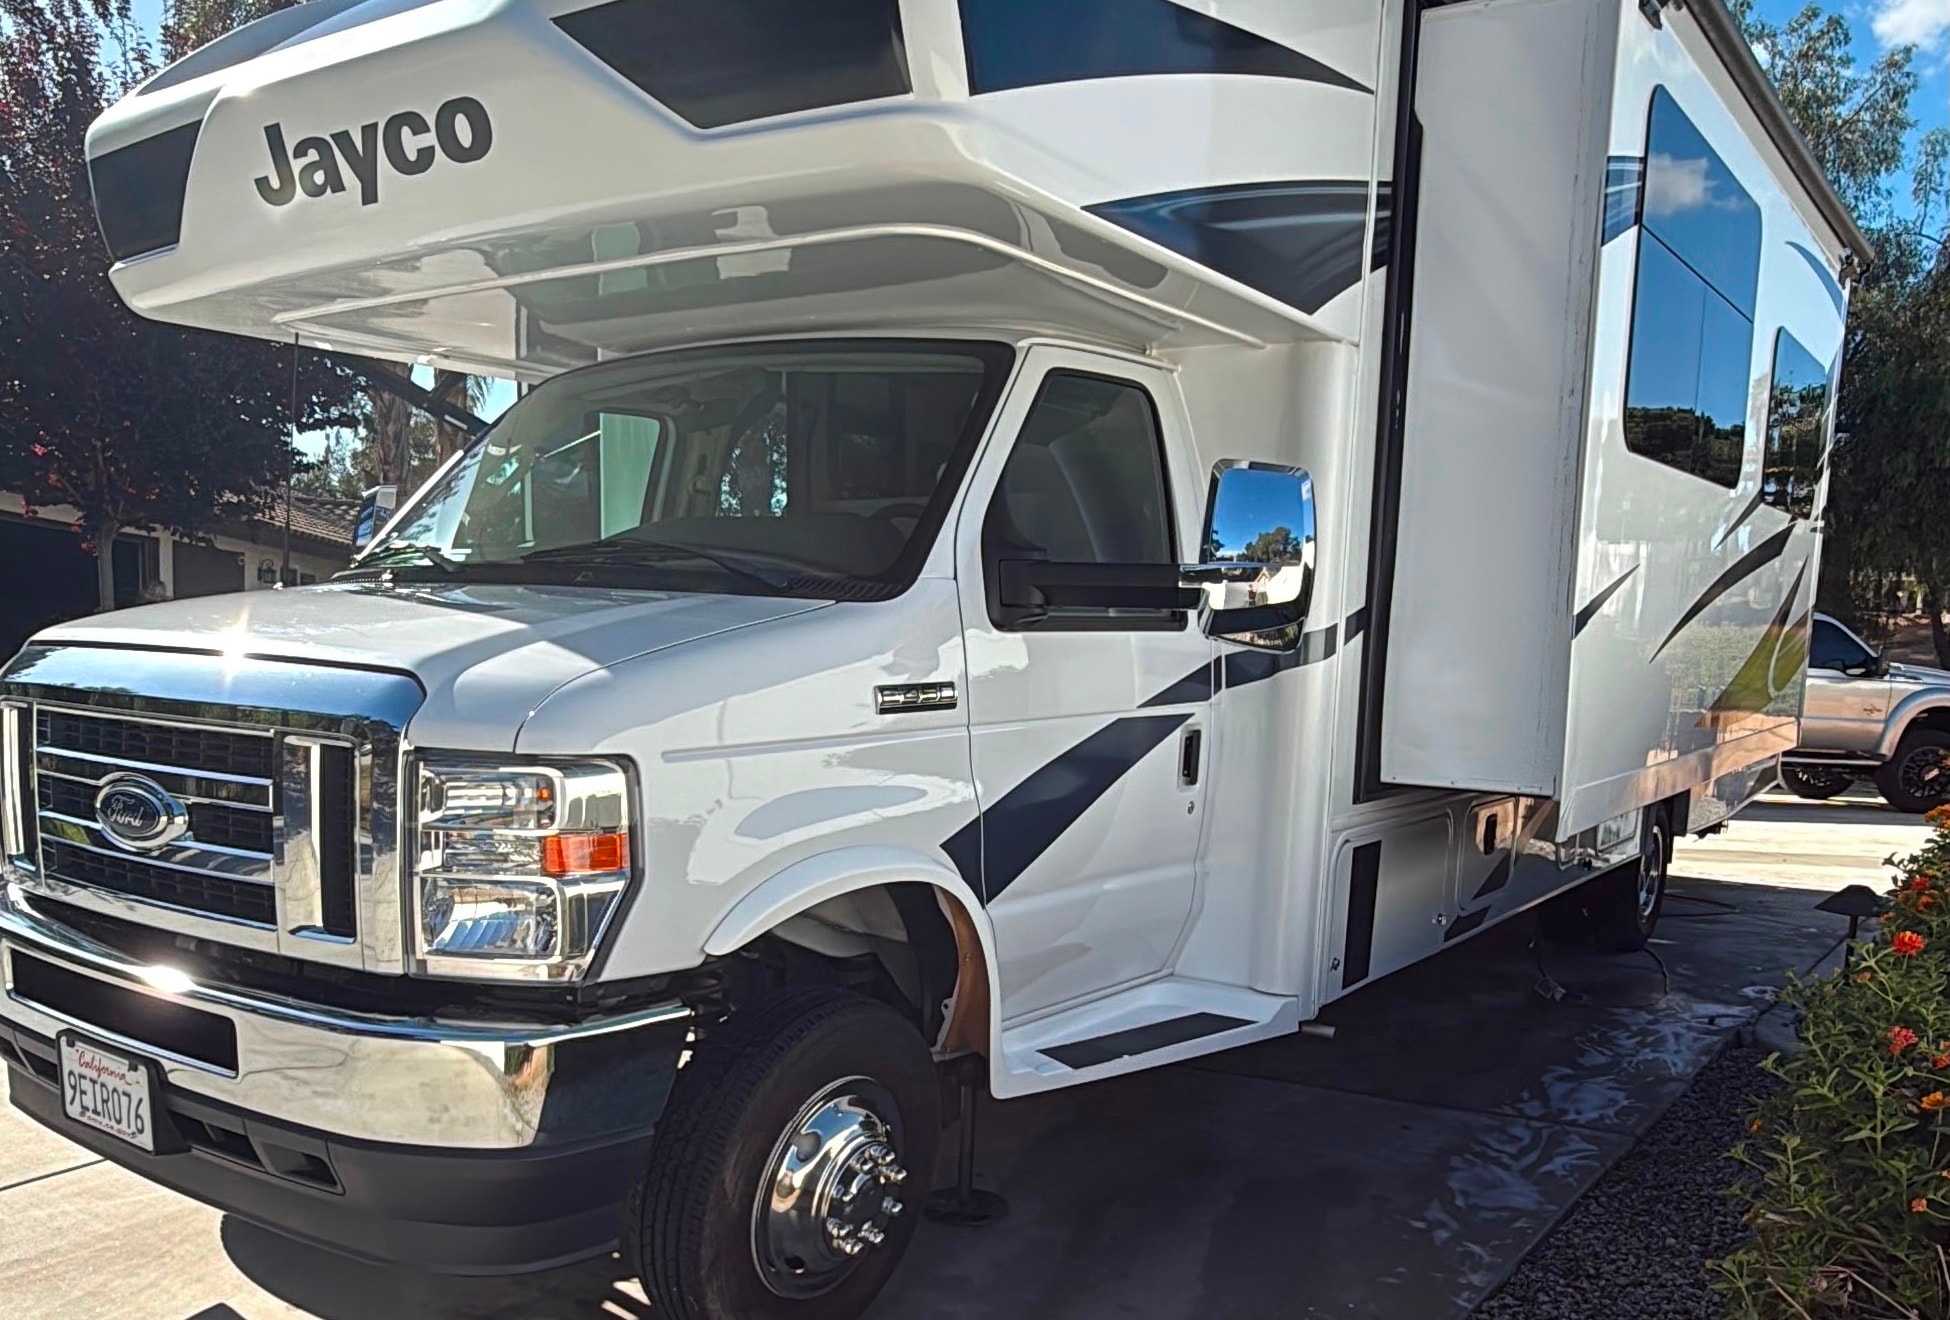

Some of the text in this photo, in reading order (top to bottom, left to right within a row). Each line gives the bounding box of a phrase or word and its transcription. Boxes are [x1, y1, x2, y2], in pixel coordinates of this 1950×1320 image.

[254, 96, 493, 206] Jayco
[107, 795, 145, 827] Ford
[78, 1049, 127, 1081] California
[68, 1070, 144, 1135] 9EIR076
